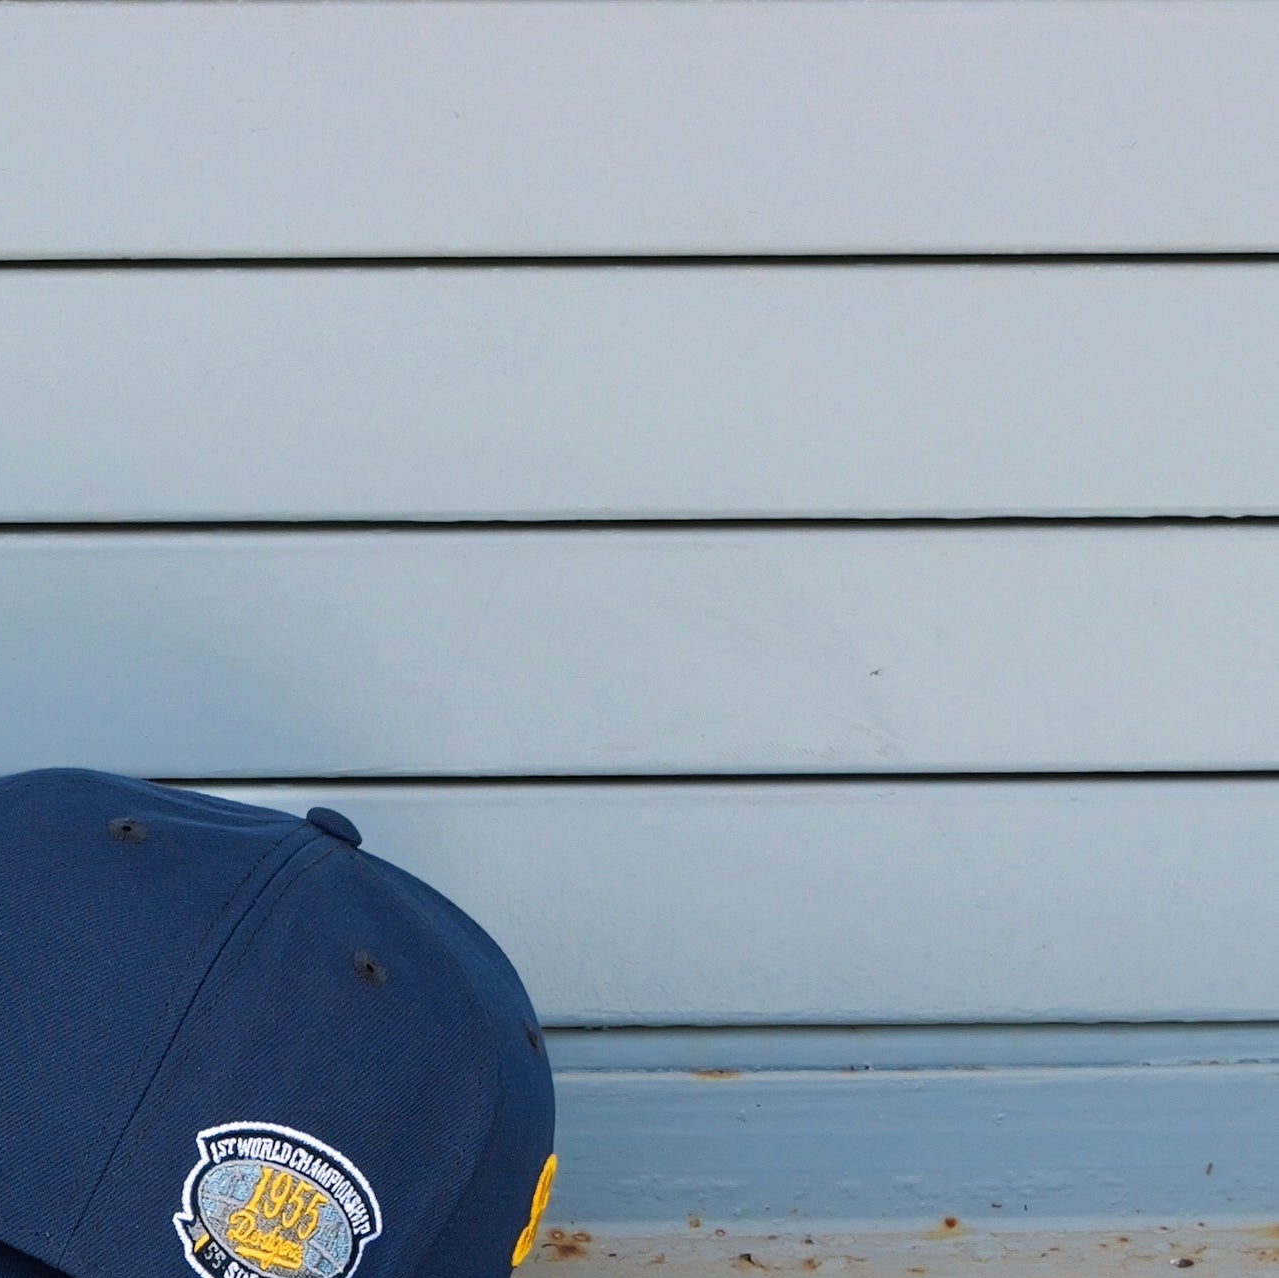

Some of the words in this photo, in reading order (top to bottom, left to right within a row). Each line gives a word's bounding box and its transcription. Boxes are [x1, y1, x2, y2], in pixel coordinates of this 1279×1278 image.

[209, 1138, 236, 1164] 1ST
[236, 1136, 292, 1164] WORLD
[290, 1148, 372, 1236] CHAMPIONSHIP
[244, 1167, 329, 1240] 1955
